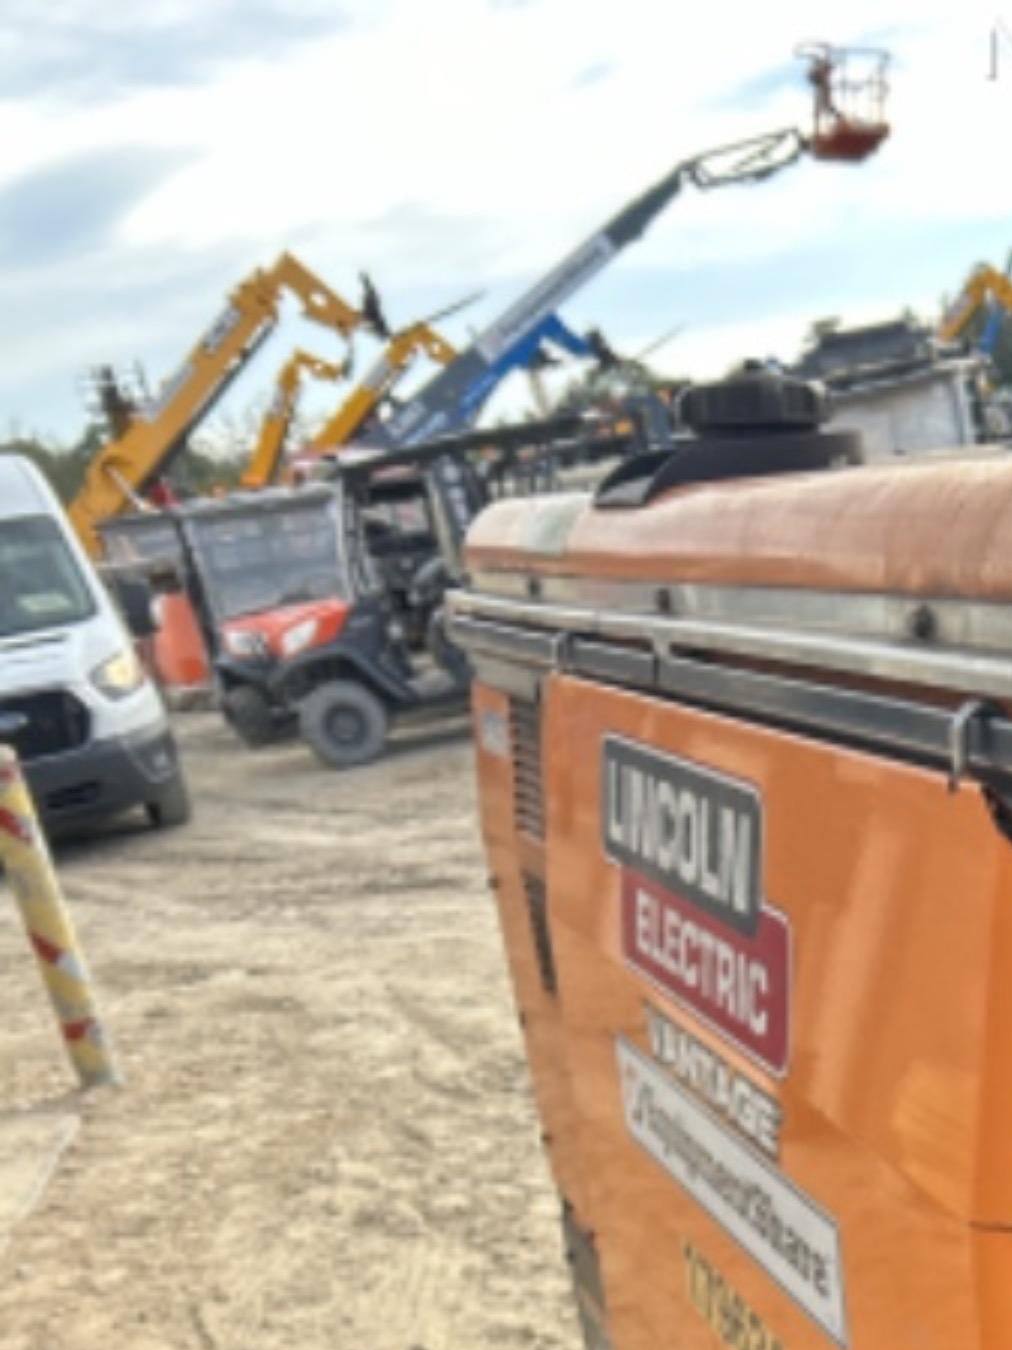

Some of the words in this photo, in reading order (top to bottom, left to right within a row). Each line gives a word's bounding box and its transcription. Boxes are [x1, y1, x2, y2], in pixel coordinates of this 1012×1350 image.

[606, 757, 752, 914] LINCOLN
[634, 888, 769, 1035] ELECTRIC
[645, 1000, 783, 1152] VANTAGE
